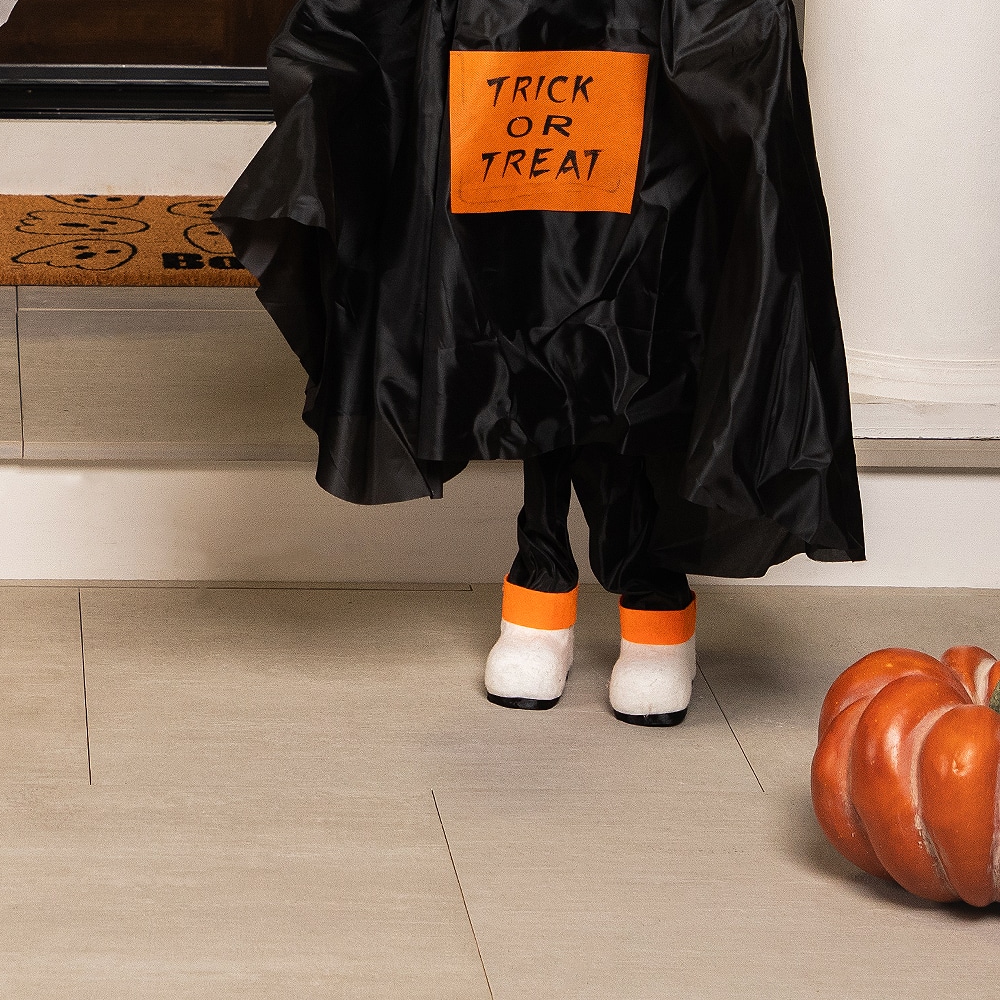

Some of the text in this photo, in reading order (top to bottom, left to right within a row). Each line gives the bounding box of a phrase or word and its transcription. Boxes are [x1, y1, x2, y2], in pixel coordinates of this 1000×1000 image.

[486, 75, 594, 107] TRICK
[506, 114, 573, 138] OR
[481, 147, 602, 182] TREAT
